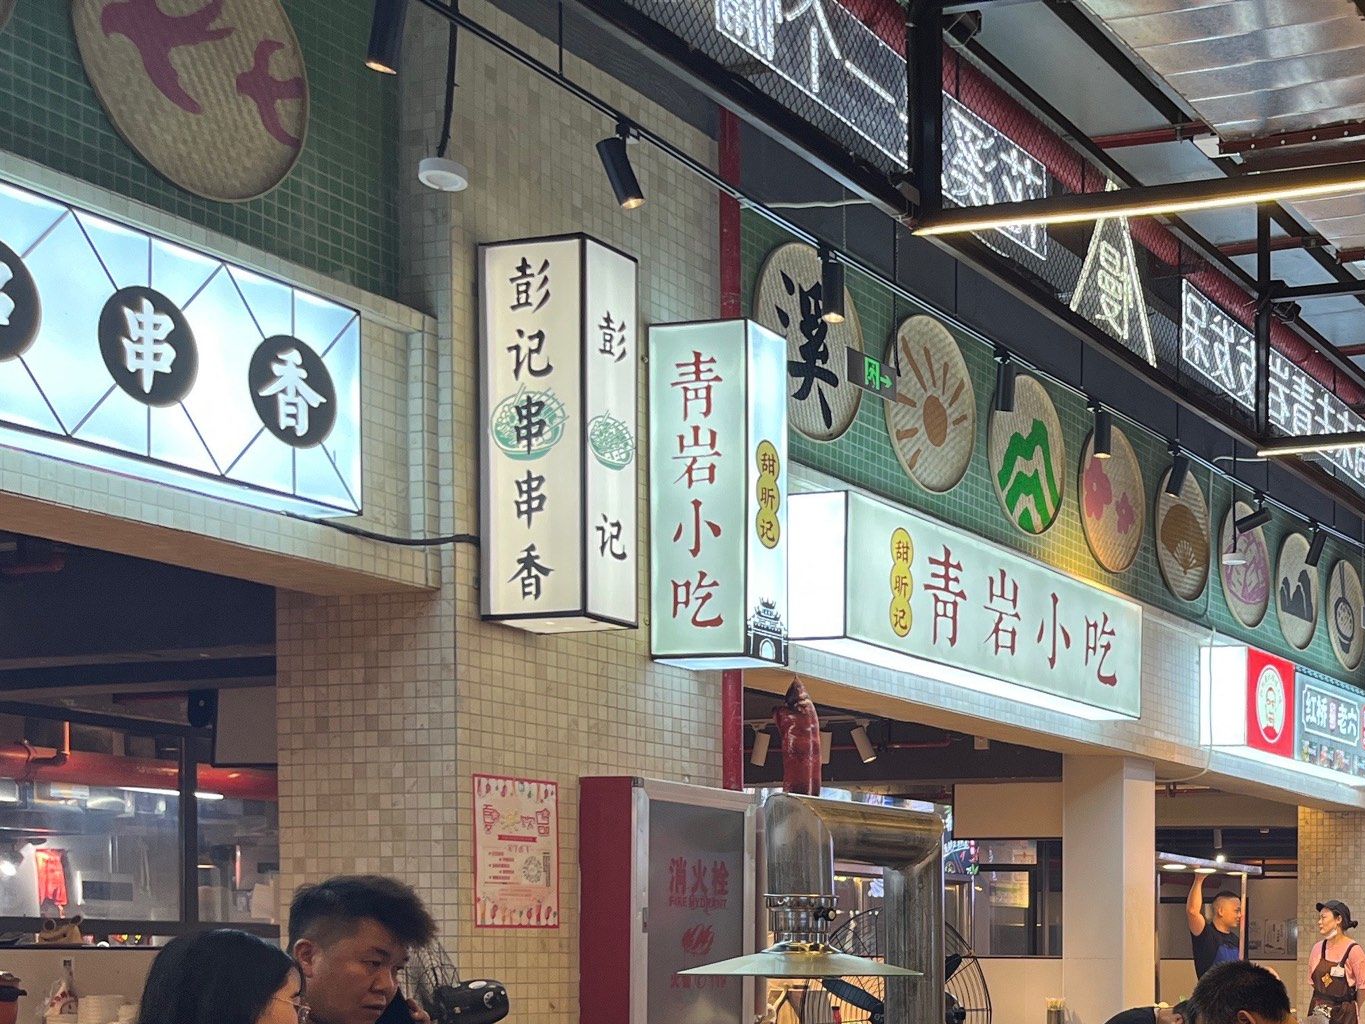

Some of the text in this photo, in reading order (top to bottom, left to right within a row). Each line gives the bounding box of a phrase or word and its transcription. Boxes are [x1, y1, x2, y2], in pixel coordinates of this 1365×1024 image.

[506, 257, 553, 601] 彭记串串香
[595, 310, 627, 561] 彭记
[669, 350, 724, 628] 青岩小吃
[759, 451, 778, 541] 甜昕记
[892, 539, 911, 631] 甜昕记
[923, 544, 1118, 688] 青岩小吃
[669, 856, 730, 897] 消火栓
